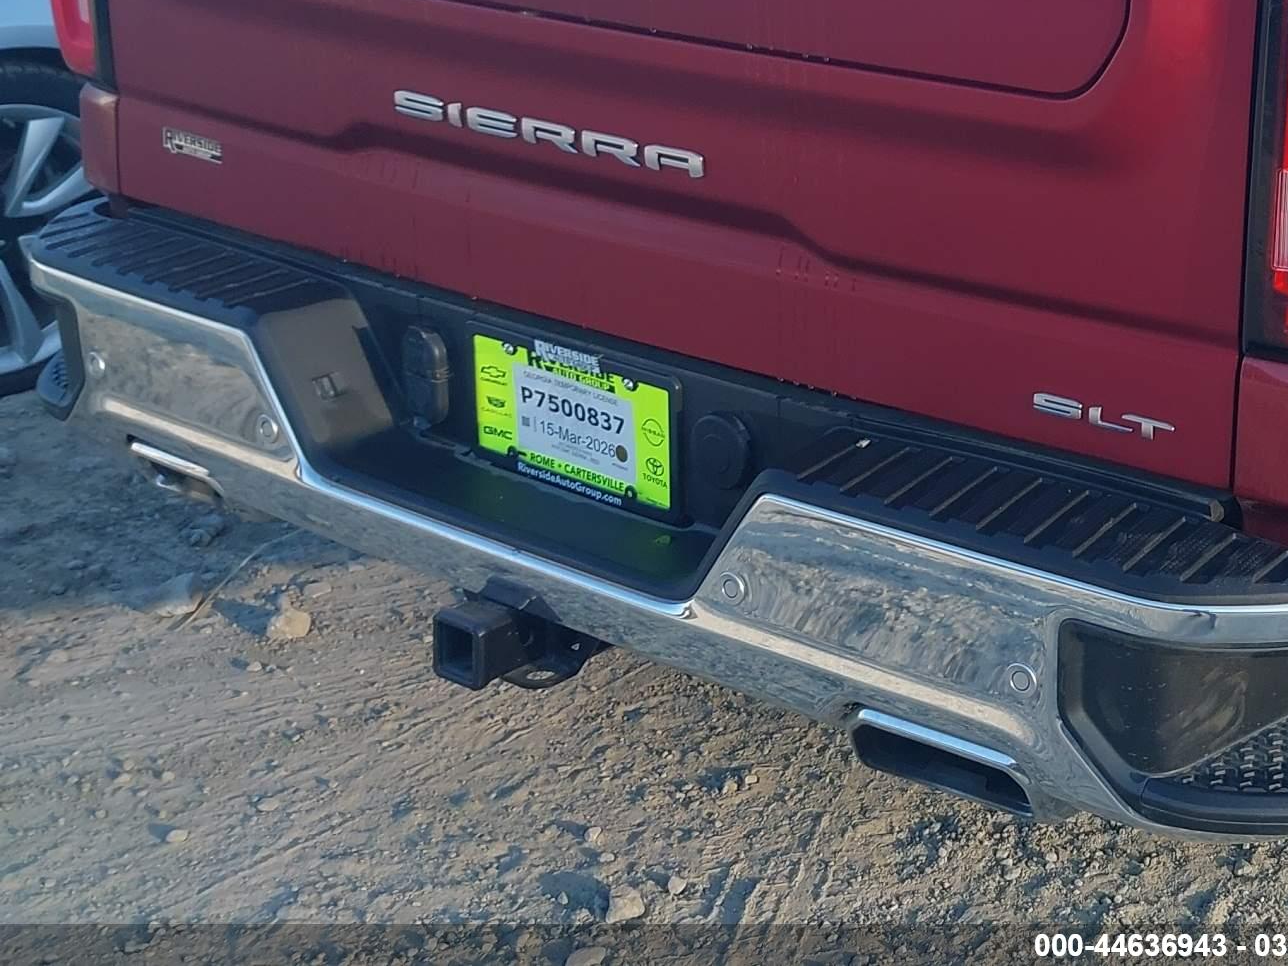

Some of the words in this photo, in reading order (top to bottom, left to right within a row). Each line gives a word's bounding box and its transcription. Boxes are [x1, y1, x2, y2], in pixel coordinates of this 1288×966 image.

[162, 127, 223, 153] RIVERSIDE
[393, 89, 706, 178] SIERRA
[534, 339, 600, 366] RIVERSIDE
[520, 386, 625, 435] P7500837
[1032, 392, 1176, 440] SLT
[483, 425, 513, 441] GMC
[539, 419, 616, 459] 15-Mar-2026
[529, 452, 556, 470] ROME
[564, 463, 625, 492] CARTERSVILLE
[642, 472, 669, 490] TOYOTA
